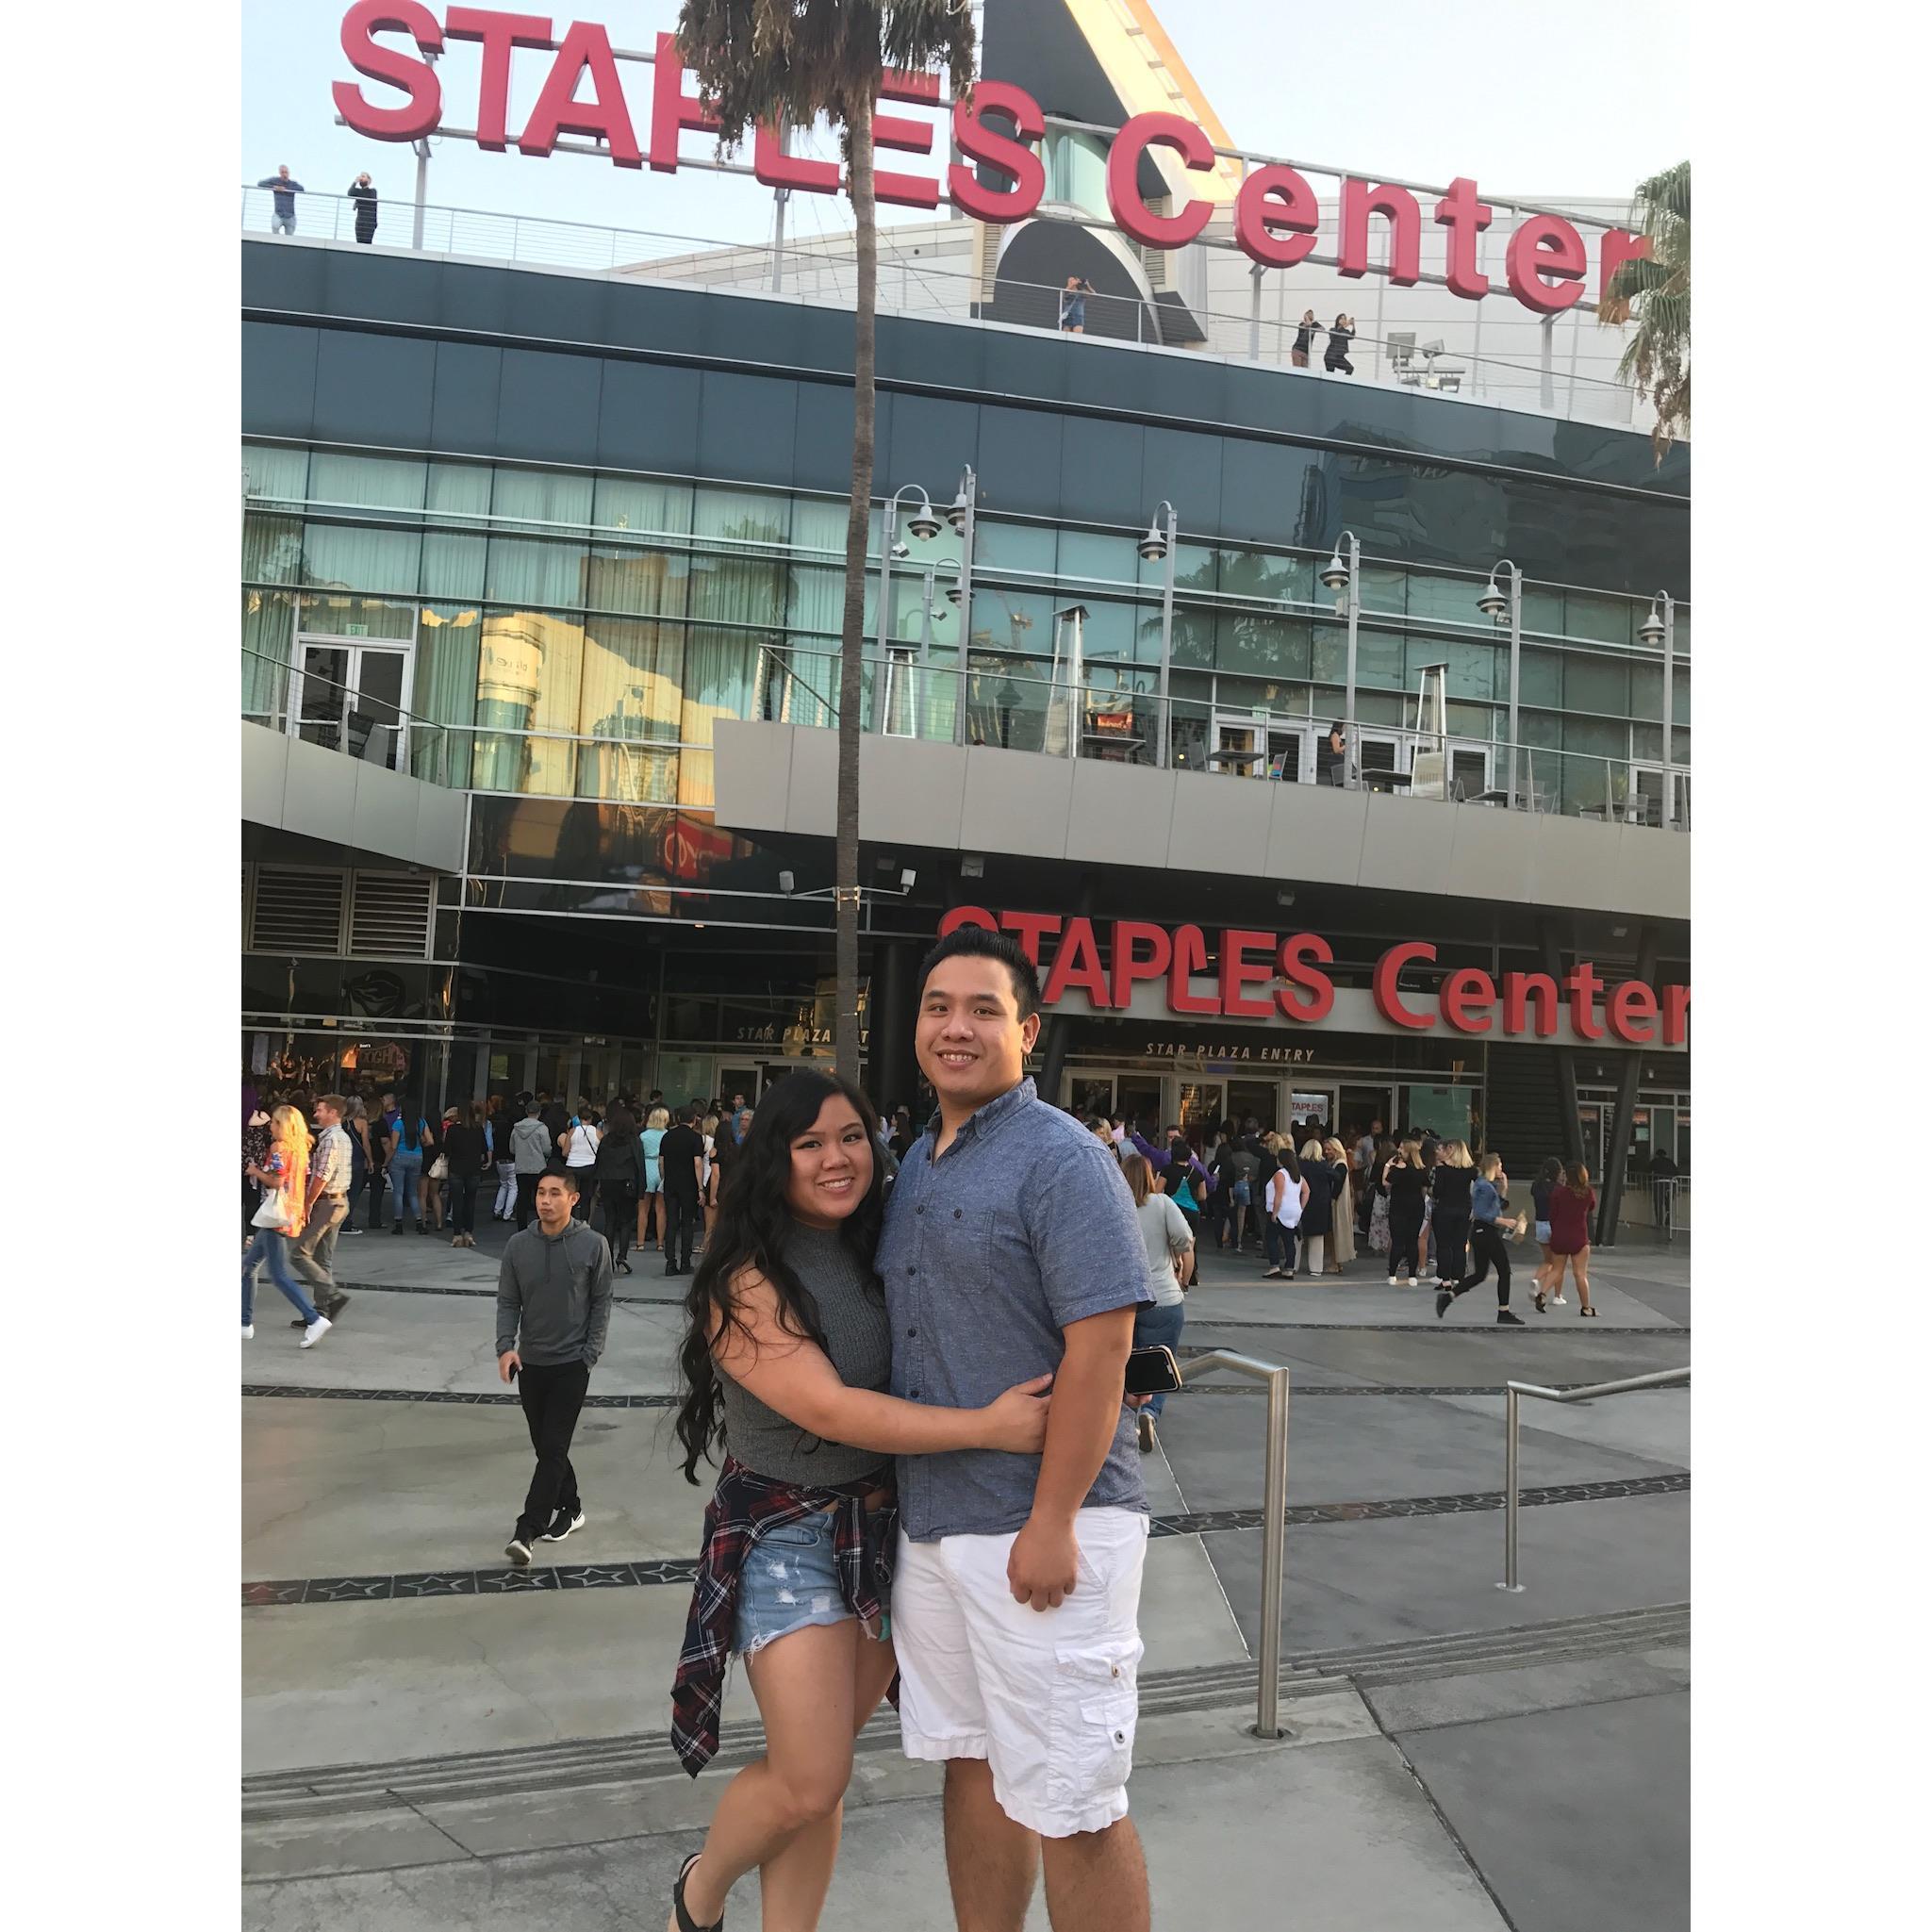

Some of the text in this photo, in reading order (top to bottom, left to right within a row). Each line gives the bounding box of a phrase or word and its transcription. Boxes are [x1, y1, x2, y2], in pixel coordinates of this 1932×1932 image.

[737, 1027, 832, 1043] STAR PLAZA
[1146, 1043, 1315, 1062] STAR PLAZA ENTRY
